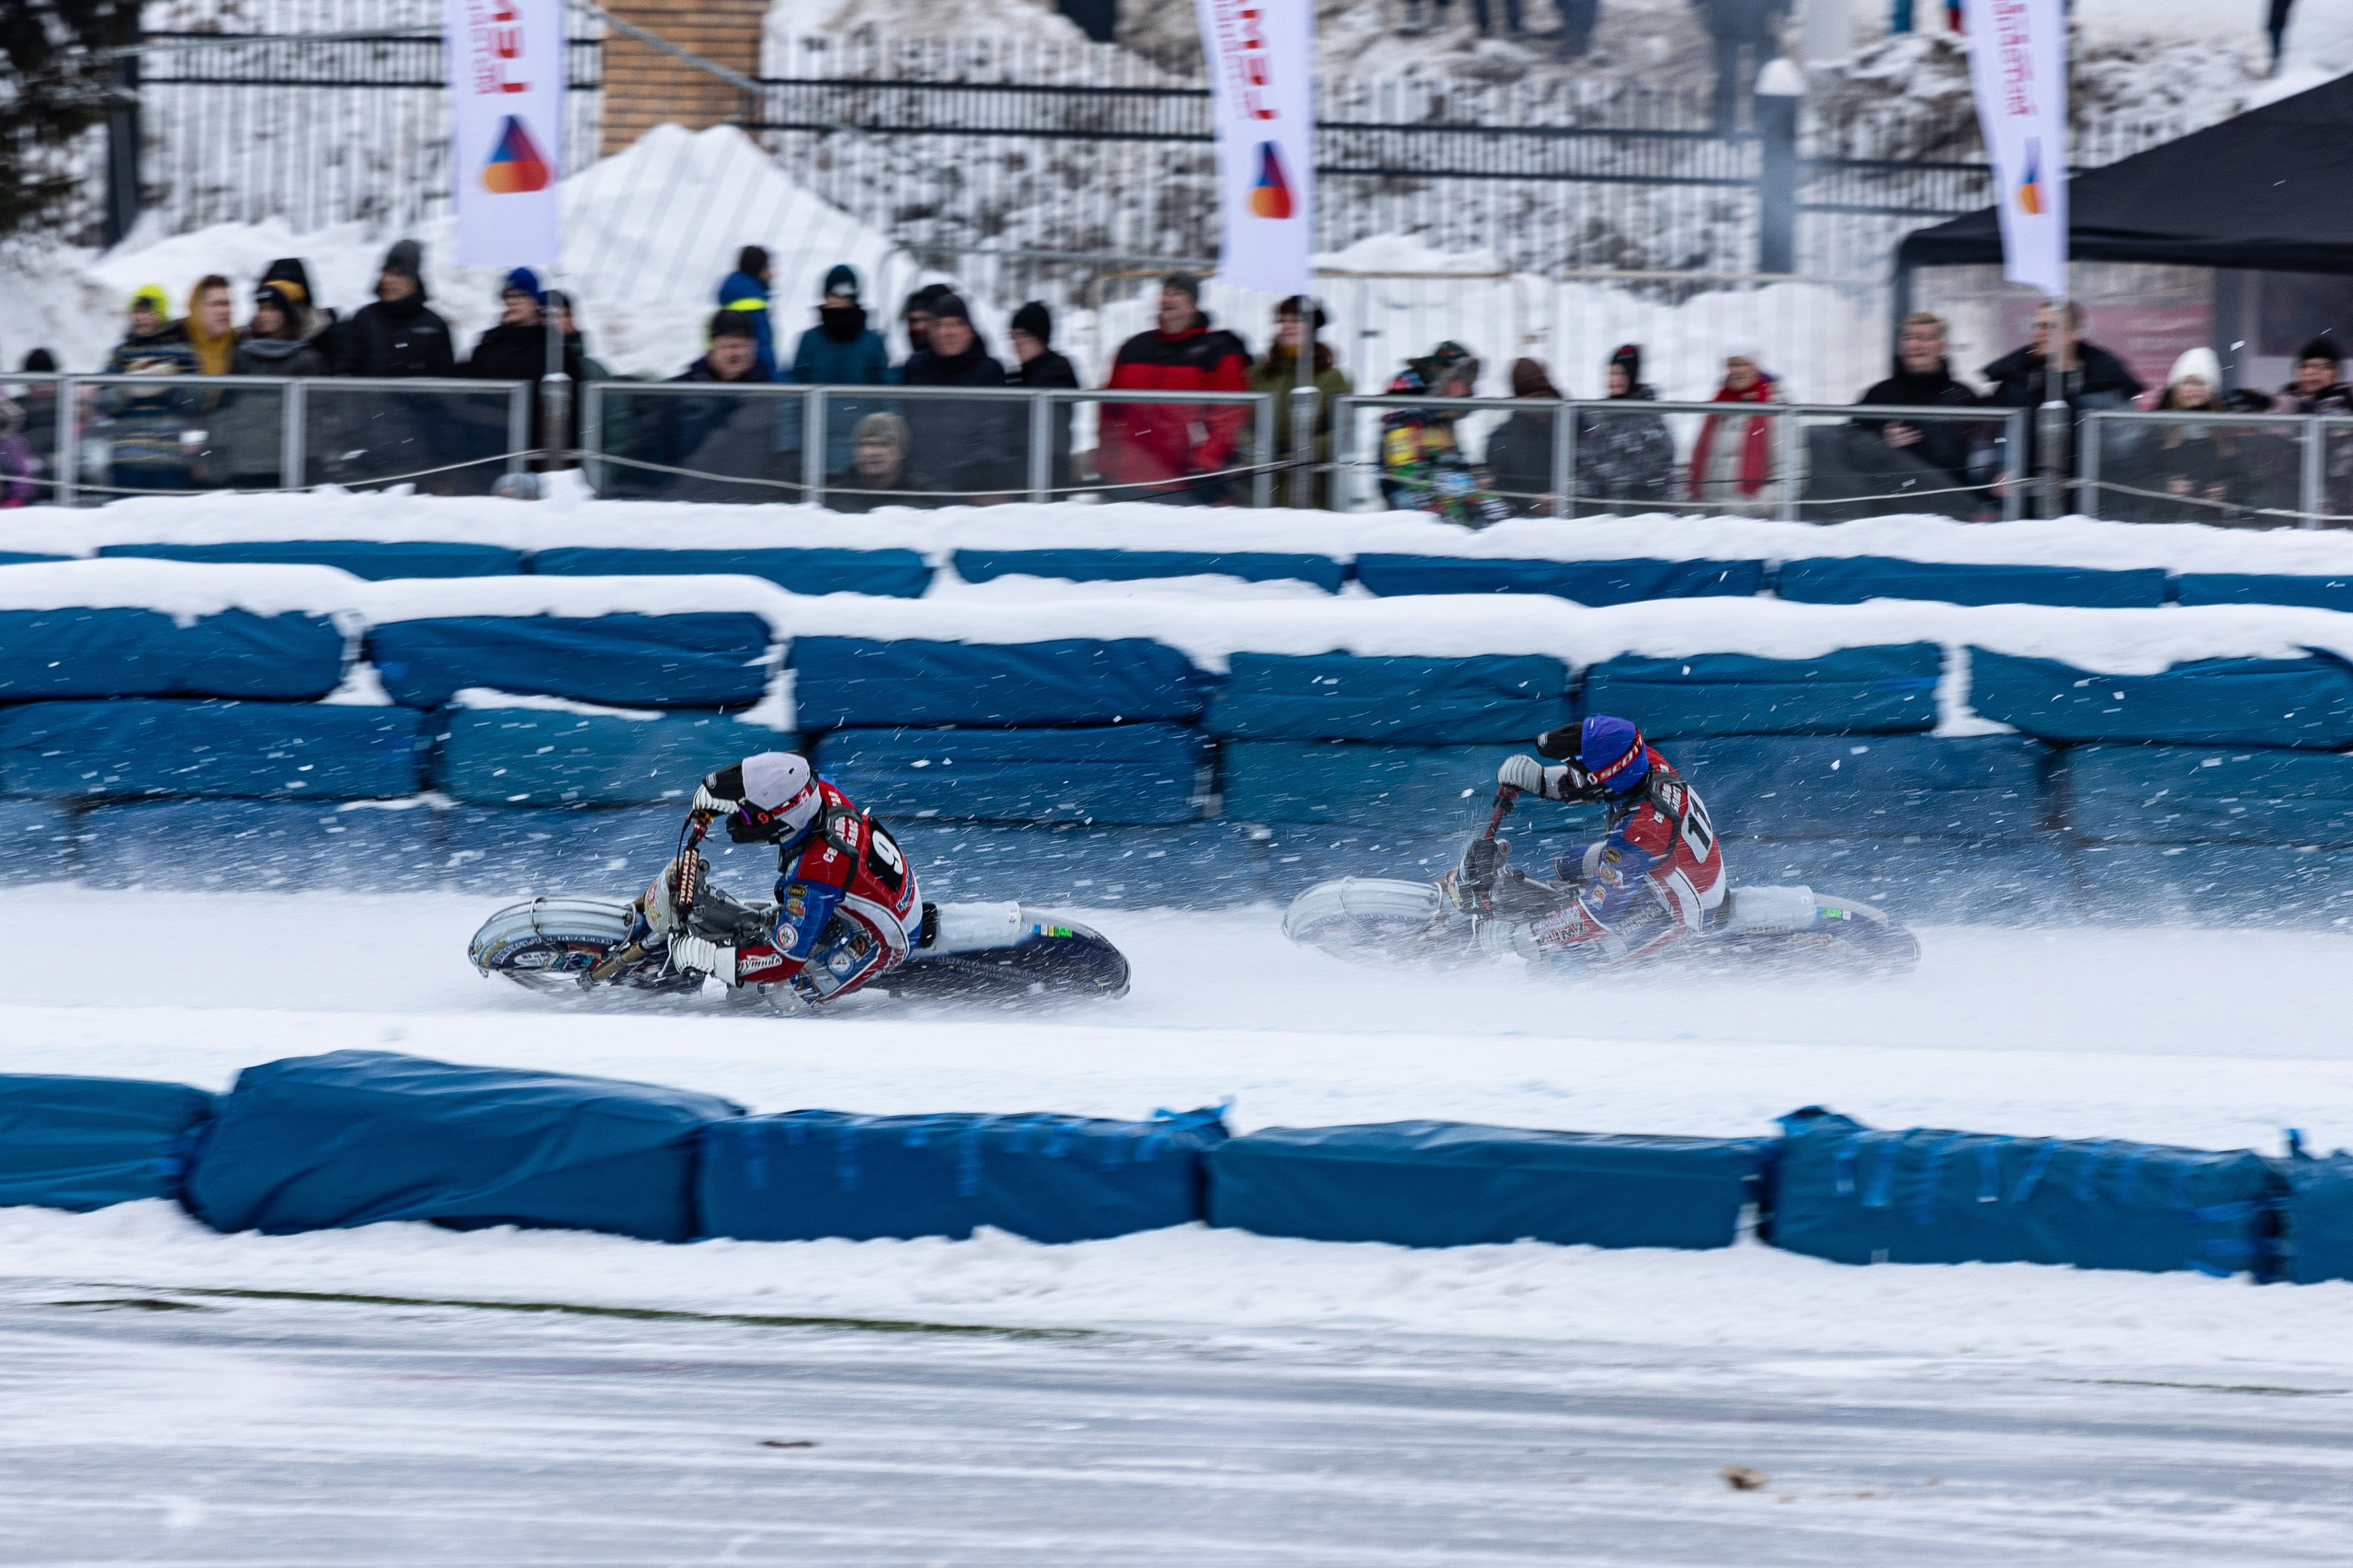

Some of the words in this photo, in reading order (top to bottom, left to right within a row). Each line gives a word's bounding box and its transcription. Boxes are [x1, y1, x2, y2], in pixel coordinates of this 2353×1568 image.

[1688, 795, 1711, 850] 11
[678, 850, 690, 905] RENTHAL
[686, 849, 699, 905] RENTHAL
[872, 830, 904, 876] 9
